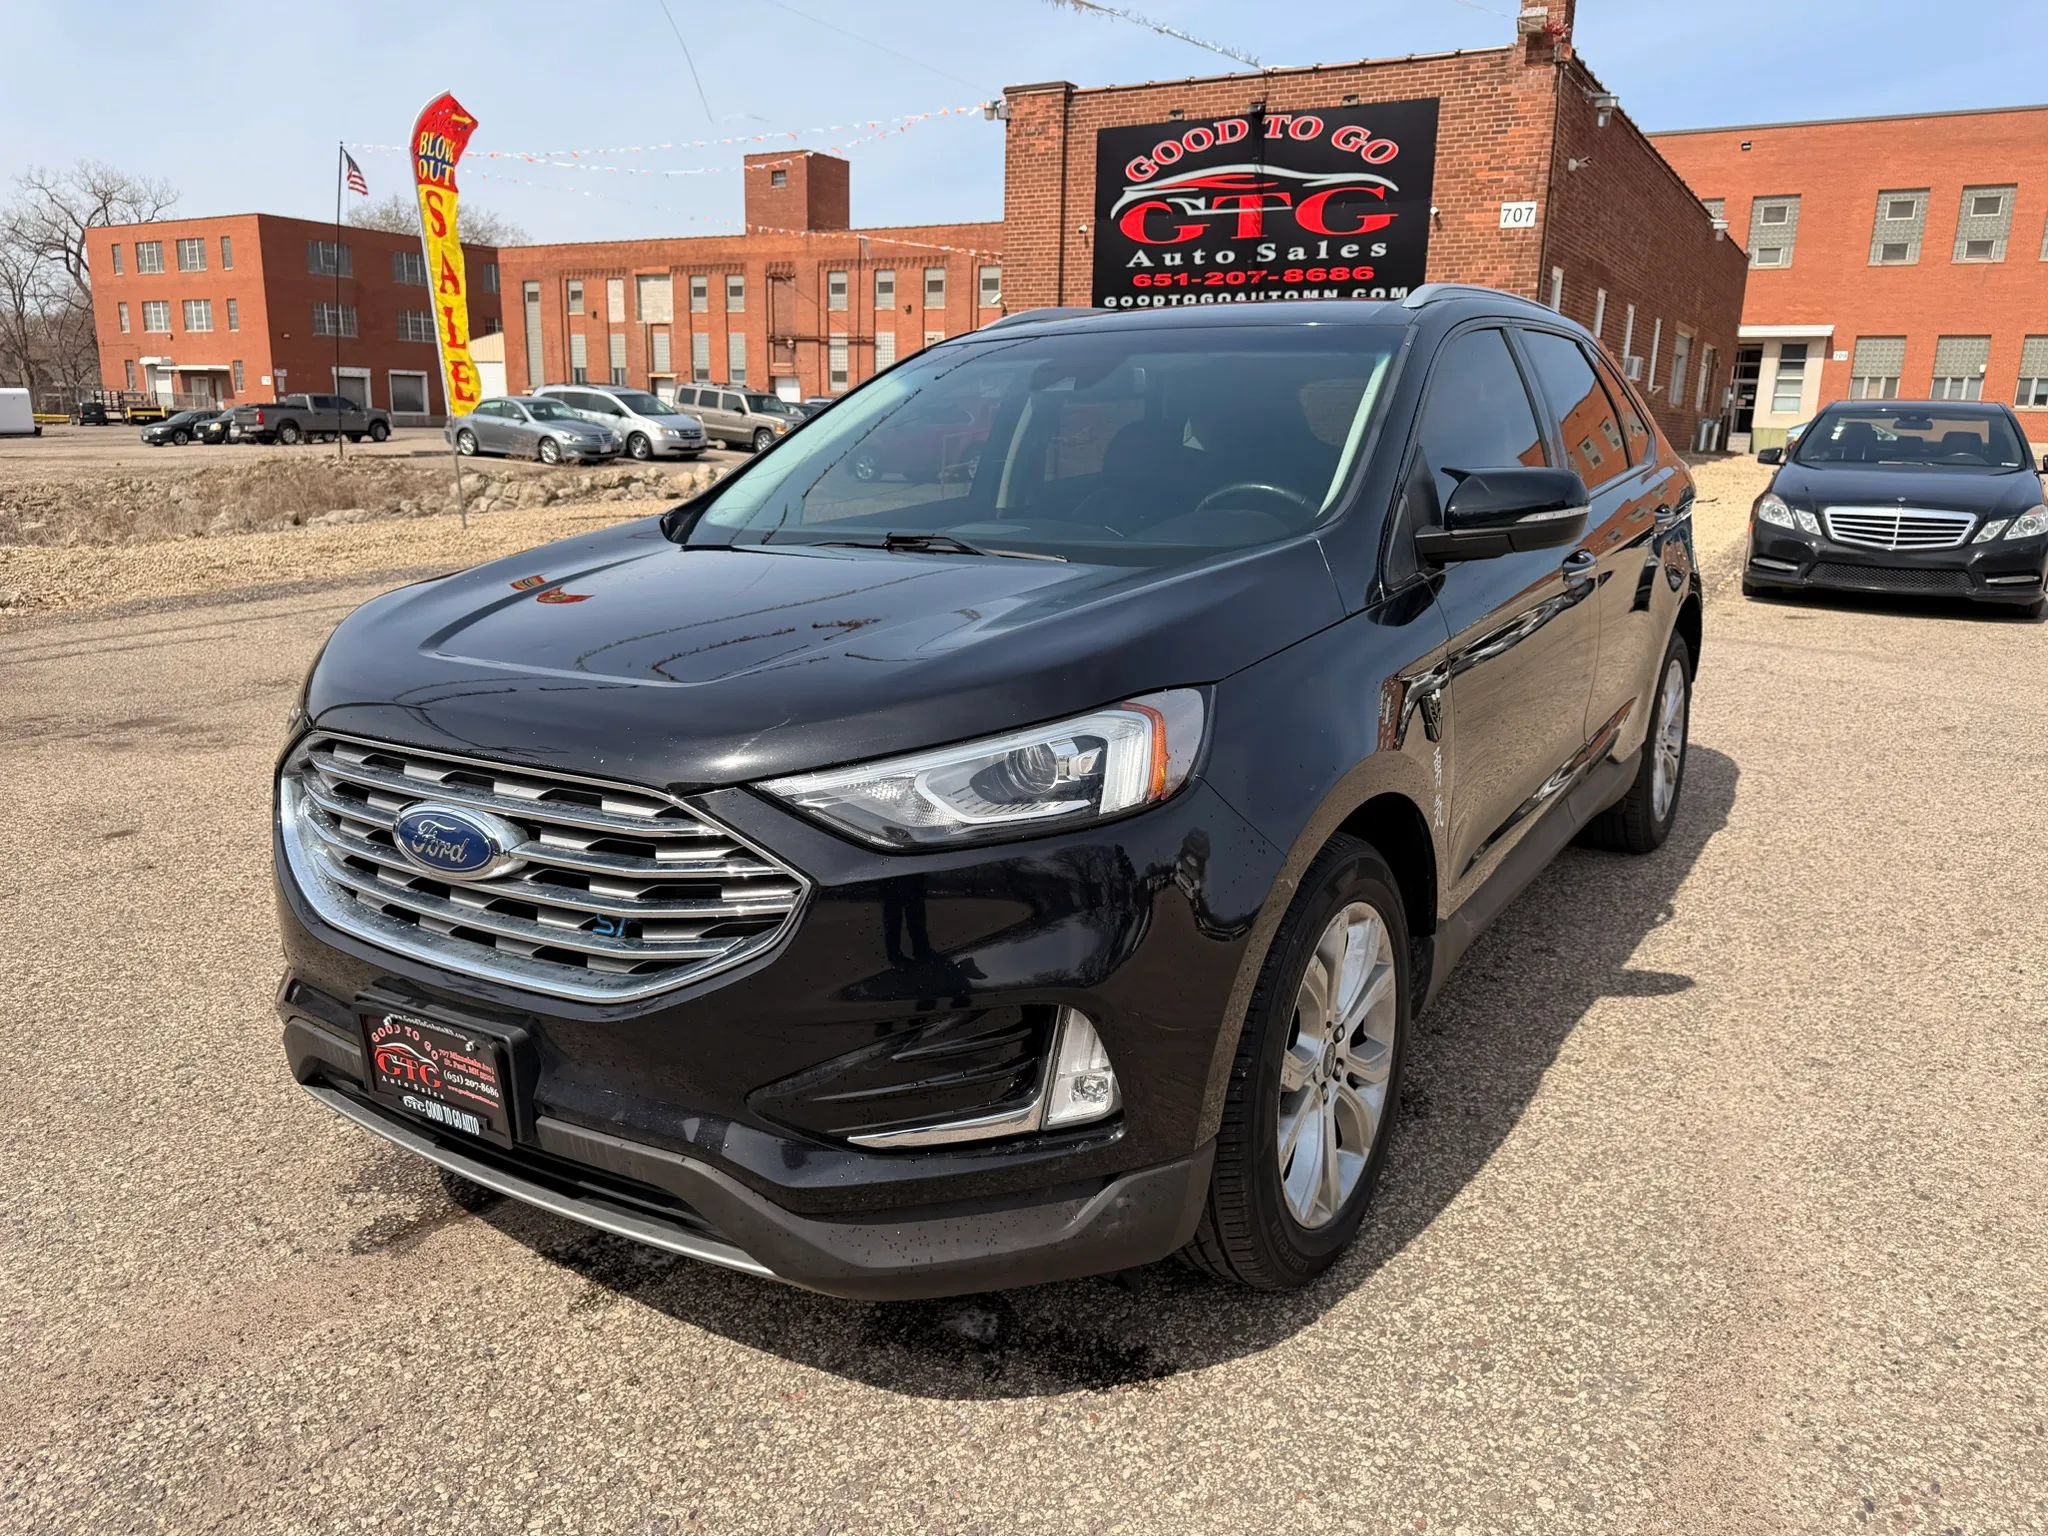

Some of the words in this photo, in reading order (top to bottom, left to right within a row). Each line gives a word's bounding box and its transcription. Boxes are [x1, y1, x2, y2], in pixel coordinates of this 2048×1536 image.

[419, 132, 456, 163] BLOW
[1125, 118, 1249, 182] GOOD
[1263, 114, 1324, 141] TO
[1331, 125, 1399, 164] GO
[418, 159, 455, 186] OUT
[1119, 186, 1399, 244] GTG
[1503, 207, 1534, 223] 707
[1125, 249, 1236, 268] Auto
[1256, 240, 1387, 263] Sales
[1132, 266, 1375, 288] 651-207-8686
[425, 190, 475, 402] SALE
[412, 819, 470, 864] Ford
[371, 1024, 401, 1042] GOOD
[404, 1026, 420, 1041] TO
[424, 1041, 439, 1060] GO
[377, 1052, 442, 1088] GTG
[443, 1069, 464, 1085] (651)
[464, 1078, 499, 1098] 207-8686
[381, 1075, 409, 1088] Auto
[413, 1083, 444, 1100] Sales
[425, 1100, 443, 1122] GOOD
[442, 1106, 452, 1126] TO
[452, 1110, 462, 1129] GO
[462, 1113, 480, 1136] AUTO
